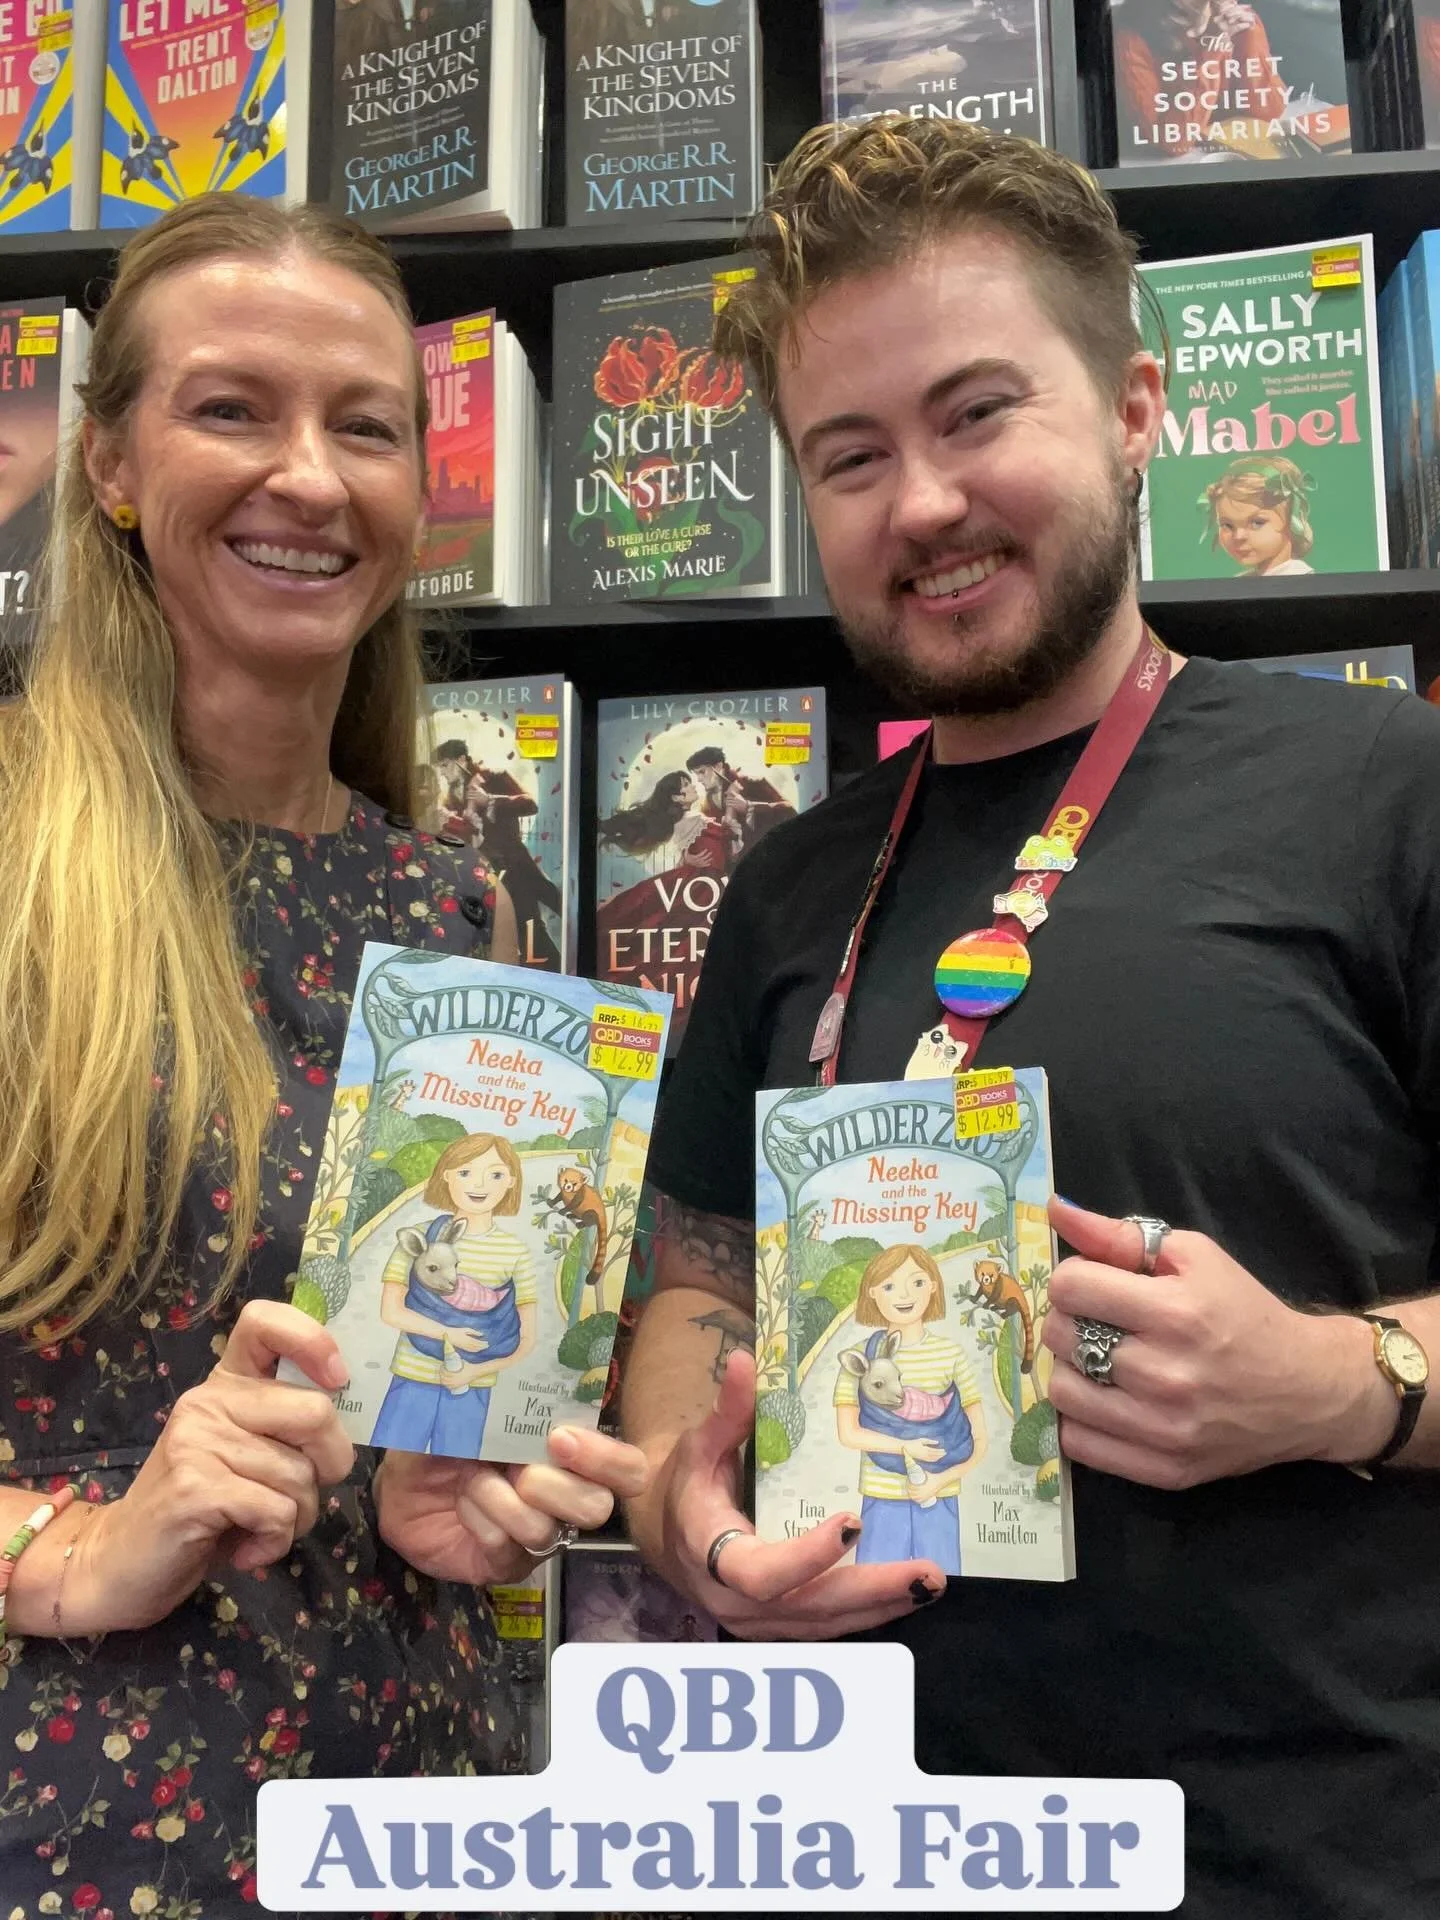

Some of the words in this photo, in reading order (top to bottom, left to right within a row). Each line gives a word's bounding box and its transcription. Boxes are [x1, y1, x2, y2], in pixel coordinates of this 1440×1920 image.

[26, 0, 62, 37] G
[120, 0, 170, 42] LET
[165, 26, 232, 70] TRENT
[341, 64, 354, 80] A
[359, 29, 458, 76] KNIGHT
[460, 20, 487, 44] OF
[576, 55, 590, 71] A
[595, 37, 708, 68] KNIGHT
[711, 35, 743, 55] OF
[1201, 32, 1234, 53] The
[158, 56, 237, 104] DALTON
[352, 77, 393, 100] THE
[398, 46, 475, 90] SEVEN
[587, 73, 634, 94] THE
[639, 59, 731, 89] SEVEN
[918, 77, 958, 94] THE
[1161, 56, 1283, 82] SECRET
[346, 68, 480, 126] KINGDOMS
[584, 85, 736, 120] KINGDOMS
[850, 88, 1034, 122] ENGTH
[1154, 85, 1295, 113] SOCIETY
[1133, 114, 1331, 145] LIBRARIANS
[344, 145, 430, 180] GEORGE
[432, 126, 477, 158] R.R.
[583, 152, 680, 177] GEORGE
[683, 141, 736, 168] R.R.
[344, 154, 476, 215] MARTIN
[585, 173, 735, 212] MARTIN
[1175, 284, 1193, 293] NEW
[1196, 281, 1218, 290] YORK
[1221, 279, 1244, 288] TIMES
[1246, 271, 1304, 285] BESTSELLING
[1182, 291, 1323, 339] SALLY
[423, 340, 468, 376] OW
[1156, 328, 1361, 373] EPWORTH
[426, 370, 470, 432] UE
[1188, 379, 1237, 404] MAD
[1156, 393, 1361, 457] Mabel
[575, 450, 754, 516] UNSEEN
[607, 536, 616, 548] IS
[617, 532, 644, 546] THEIR
[646, 528, 670, 542] LOVE
[672, 528, 679, 539] A
[681, 524, 712, 537] CURSE
[625, 546, 640, 558] OR
[641, 544, 660, 556] THE
[661, 540, 692, 553] CURE?
[592, 564, 657, 591] ALEXIS
[661, 555, 726, 579] MARIE
[432, 686, 532, 708] CROZIER
[630, 700, 673, 720] LILY
[688, 697, 789, 718] CROZIER
[1048, 805, 1089, 848] QB
[654, 876, 729, 912] VO
[638, 973, 700, 1009] NI
[407, 988, 592, 1065] WILDERZO
[595, 1027, 623, 1043] QBD
[624, 1034, 652, 1047] BOOKS
[467, 1038, 543, 1077] Neeka
[478, 1072, 503, 1086] and
[506, 1075, 527, 1091] the
[956, 1079, 973, 1090] RP:
[420, 1071, 527, 1127] Missing
[529, 1090, 577, 1136] Key
[958, 1114, 967, 1135] $
[976, 1104, 1014, 1133] 12.99
[867, 1155, 939, 1183] Neeka
[881, 1186, 905, 1200] and
[908, 1184, 927, 1198] the
[831, 1198, 929, 1233] Missing
[935, 1191, 978, 1232] Key
[518, 1380, 559, 1394] Illustrated
[524, 1397, 553, 1417] Max
[504, 1414, 556, 1437] Hamilt
[982, 1483, 1019, 1496] Illustrated
[799, 1498, 825, 1518] Tina
[993, 1501, 1020, 1522] Max
[976, 1523, 1037, 1545] Hamilton
